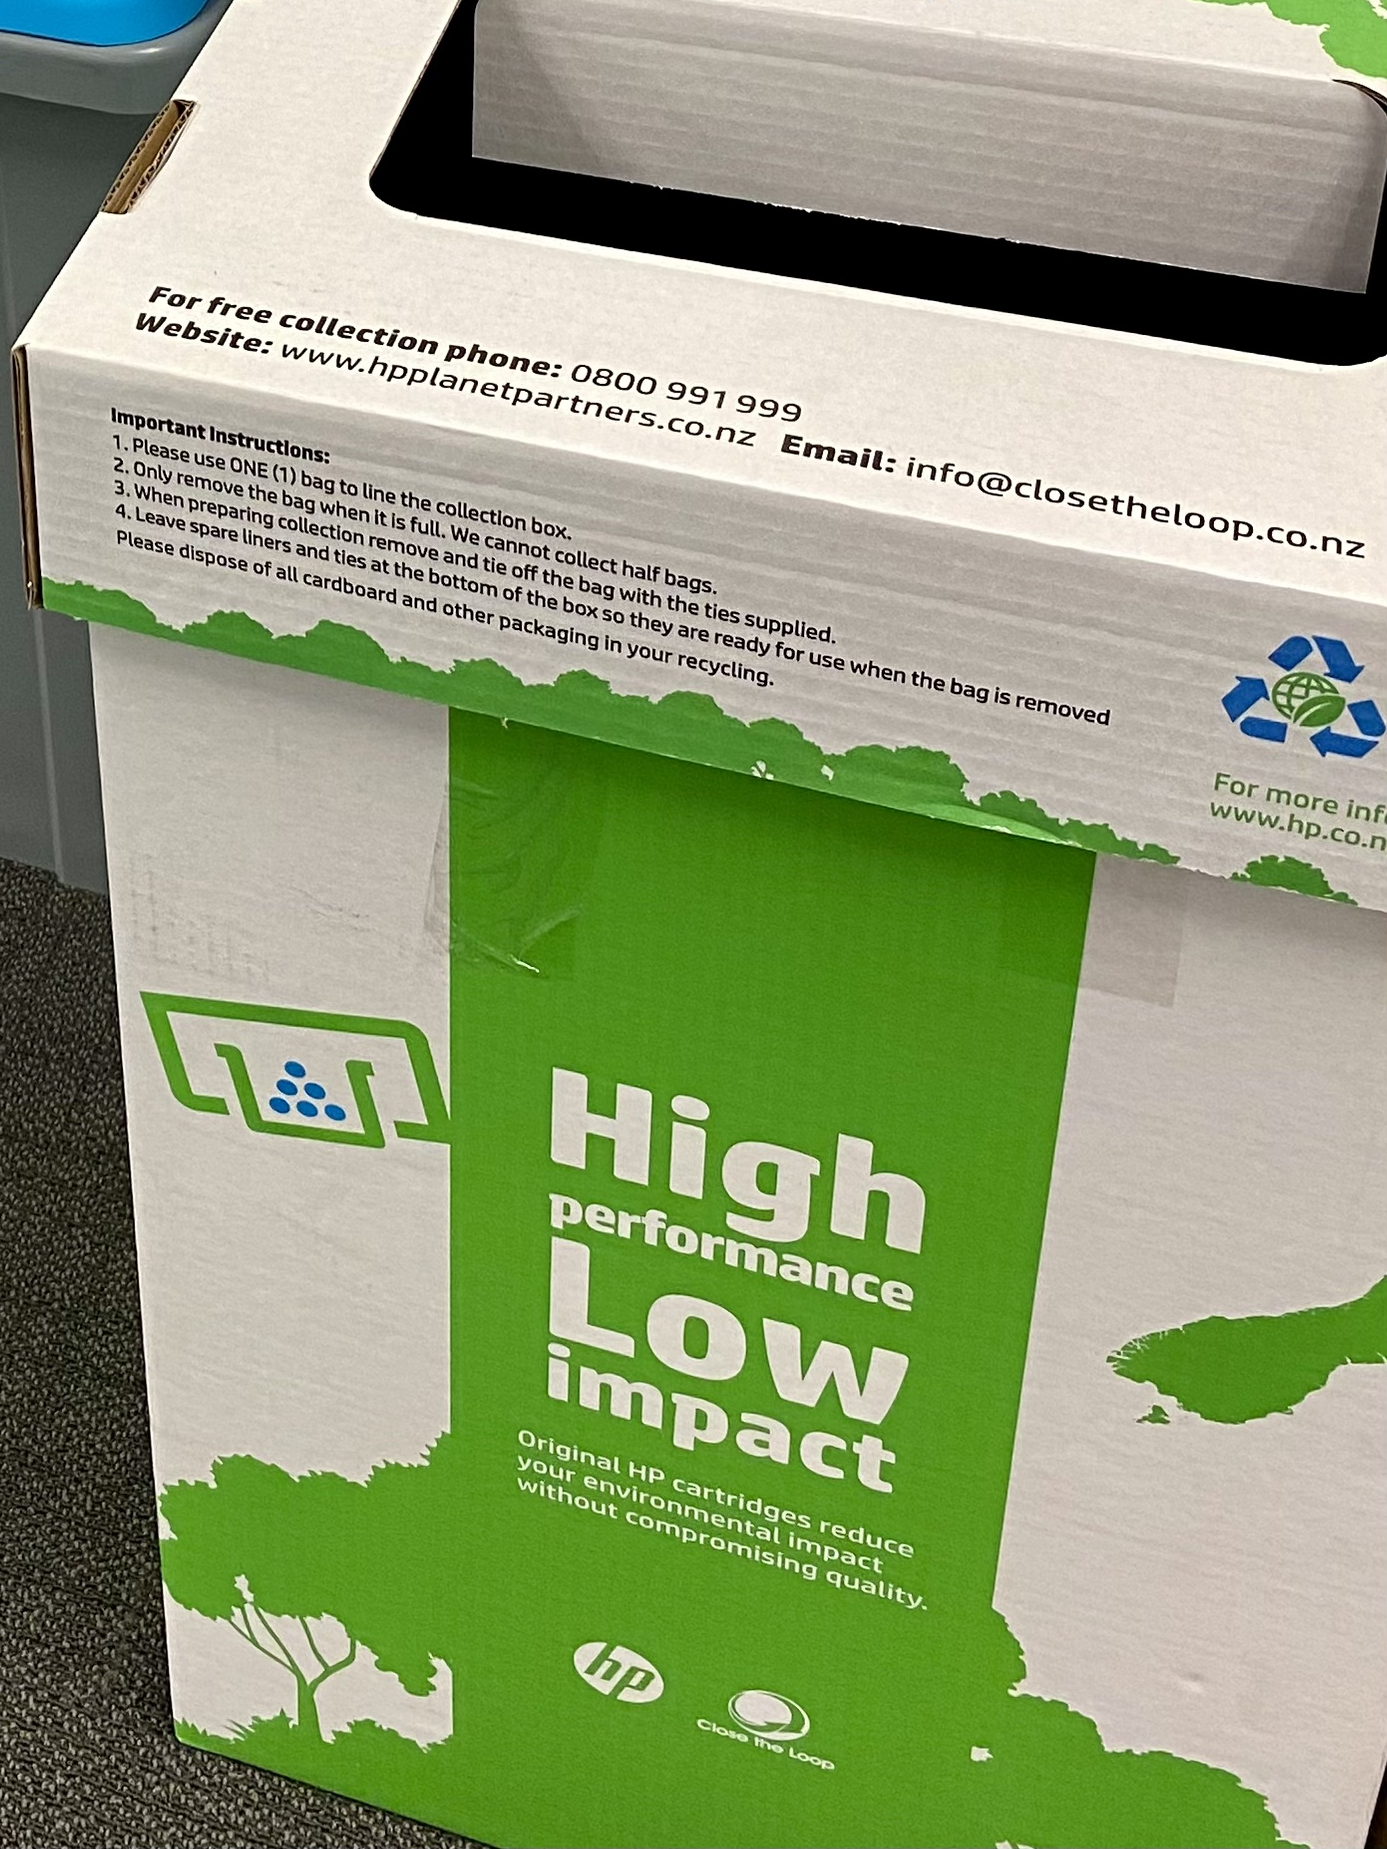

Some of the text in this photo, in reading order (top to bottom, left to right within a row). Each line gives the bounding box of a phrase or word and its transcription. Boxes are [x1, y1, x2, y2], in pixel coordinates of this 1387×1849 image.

[148, 286, 801, 422] For free collection phone: 0800 991 999
[111, 407, 330, 464] Important Instructions:
[113, 435, 572, 541] 1. Please use ONE (1) bag to line the collection box.
[136, 313, 1365, 559] Website: www.hpplanetpartners.co.nz Email: info@closetheloop.co.nz
[114, 457, 717, 595] 2. Only remove the bag when it is full. We cannot collect half bags.
[117, 530, 774, 687] Please dispose of all cardboard and other packaging in your recycling.
[1214, 772, 1387, 825] For more inf
[550, 1066, 926, 1254] High
[548, 1193, 914, 1311] performance
[548, 1236, 909, 1425] Low
[547, 1343, 896, 1493] impact
[517, 1455, 883, 1574] your environmental impact
[517, 1477, 927, 1610] without compromising quality.
[518, 1430, 914, 1558] Original HP cartridges reduce
[578, 1642, 660, 1703] hp
[696, 1718, 835, 1770] Close the Loop
